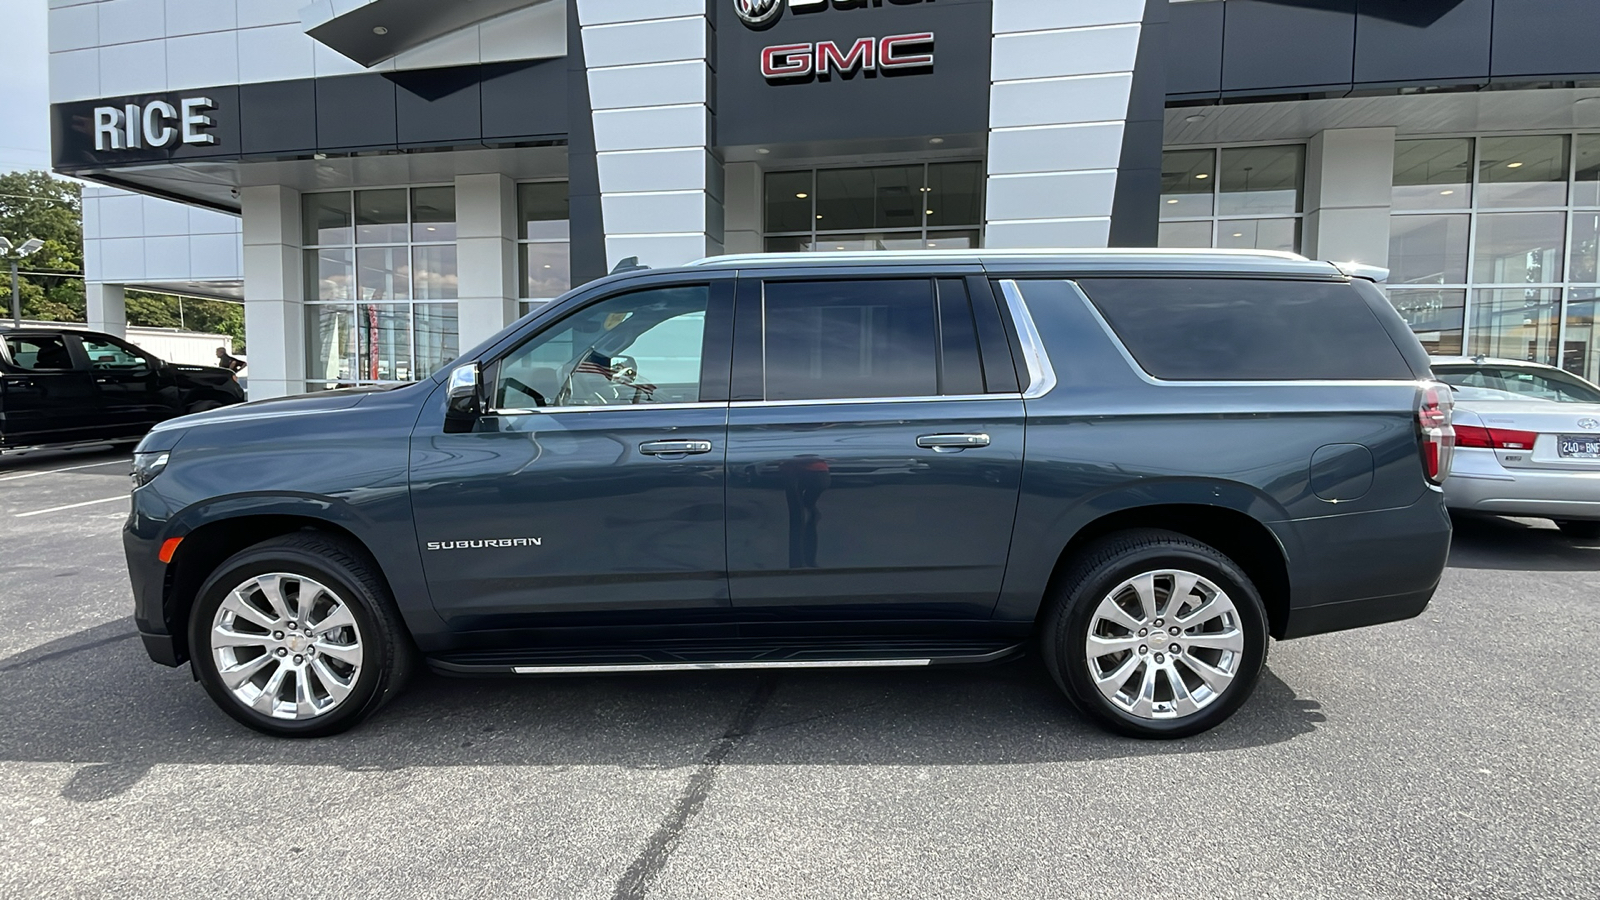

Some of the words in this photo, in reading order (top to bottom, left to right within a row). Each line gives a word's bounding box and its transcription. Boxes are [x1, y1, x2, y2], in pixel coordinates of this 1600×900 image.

[761, 32, 934, 78] GMC
[94, 97, 214, 151] RICE
[427, 537, 542, 550] SUBURBAN
